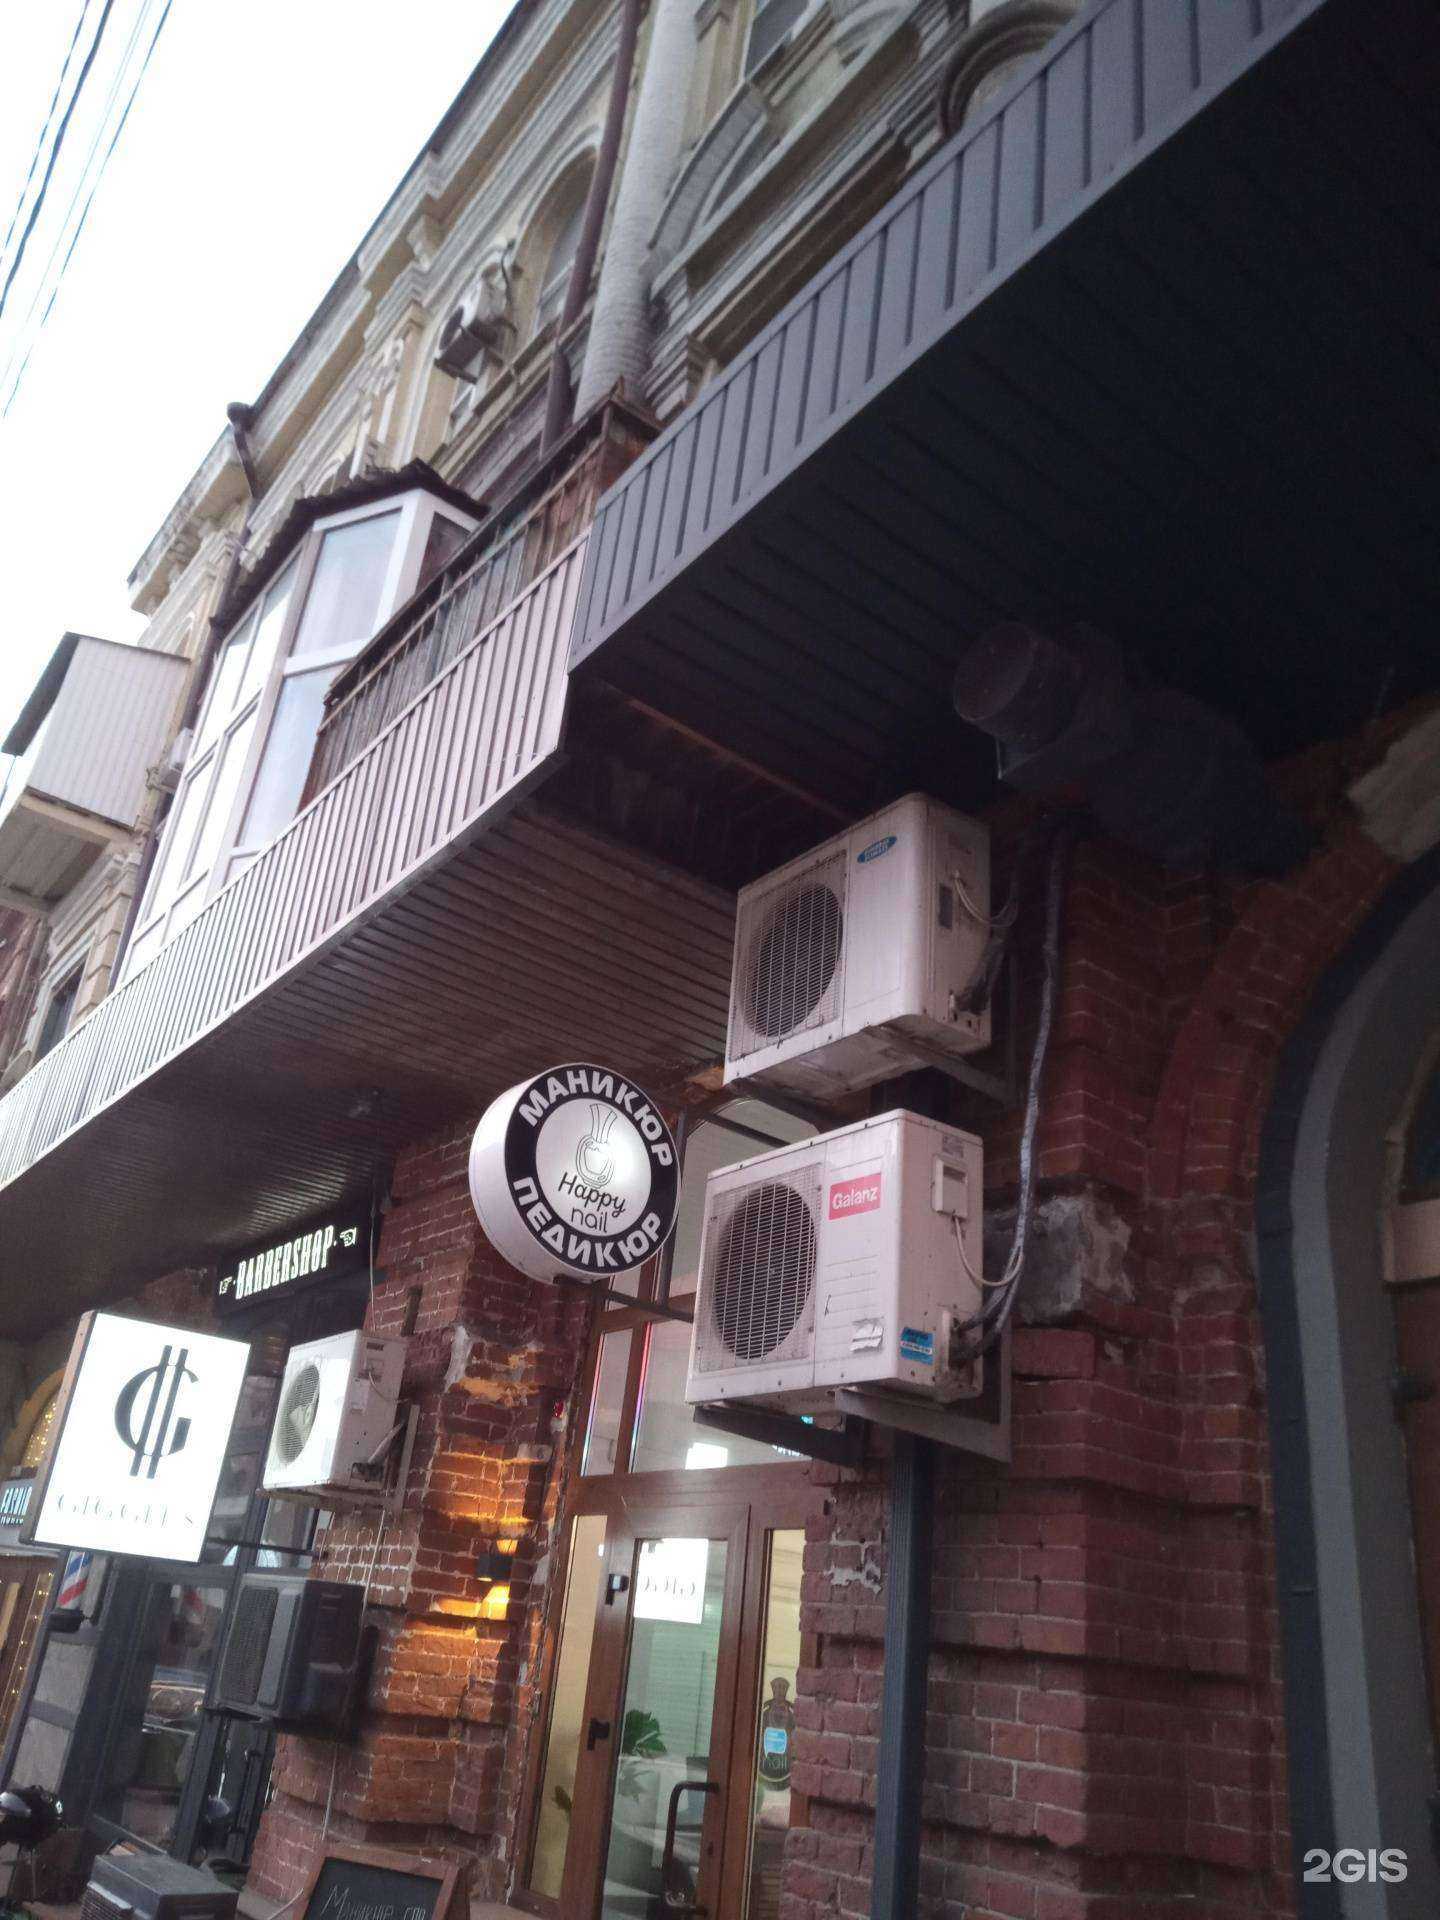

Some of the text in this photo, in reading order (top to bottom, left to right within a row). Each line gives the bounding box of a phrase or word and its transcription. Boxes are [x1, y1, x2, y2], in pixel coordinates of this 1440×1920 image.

[519, 1069, 673, 1167] МАНИКЮР
[513, 1176, 661, 1268] ПЕДИКЮР
[558, 1171, 626, 1218] Happy
[570, 1206, 609, 1233] nail
[832, 1187, 879, 1210] Galanz
[235, 1225, 334, 1300] BARBERSHOP
